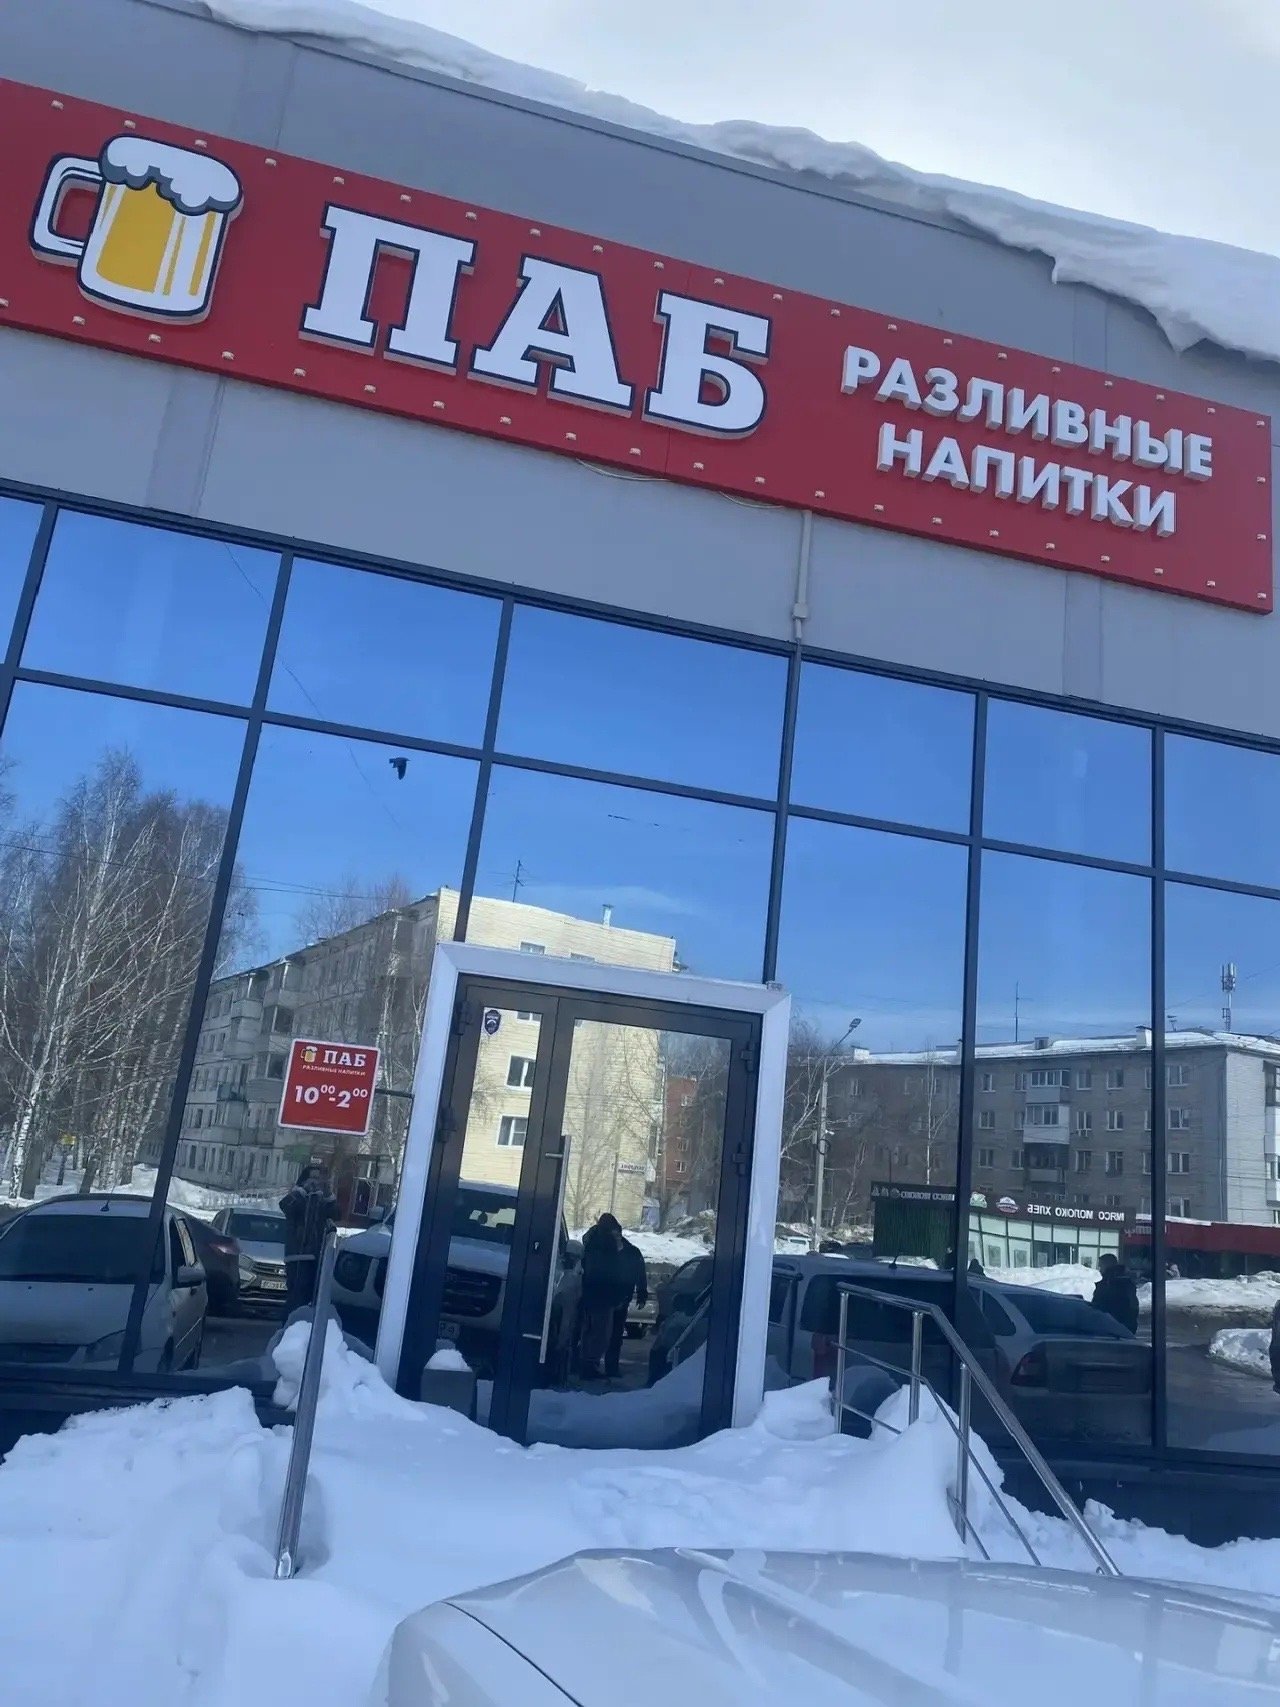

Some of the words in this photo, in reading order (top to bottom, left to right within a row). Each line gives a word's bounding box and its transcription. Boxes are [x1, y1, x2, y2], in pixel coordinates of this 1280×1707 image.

[300, 202, 771, 440] ПАБ
[840, 344, 1214, 482] РАЗЛИВНЫЕ
[876, 422, 1178, 538] НАПИТКИ
[323, 1050, 367, 1067] ПАБ
